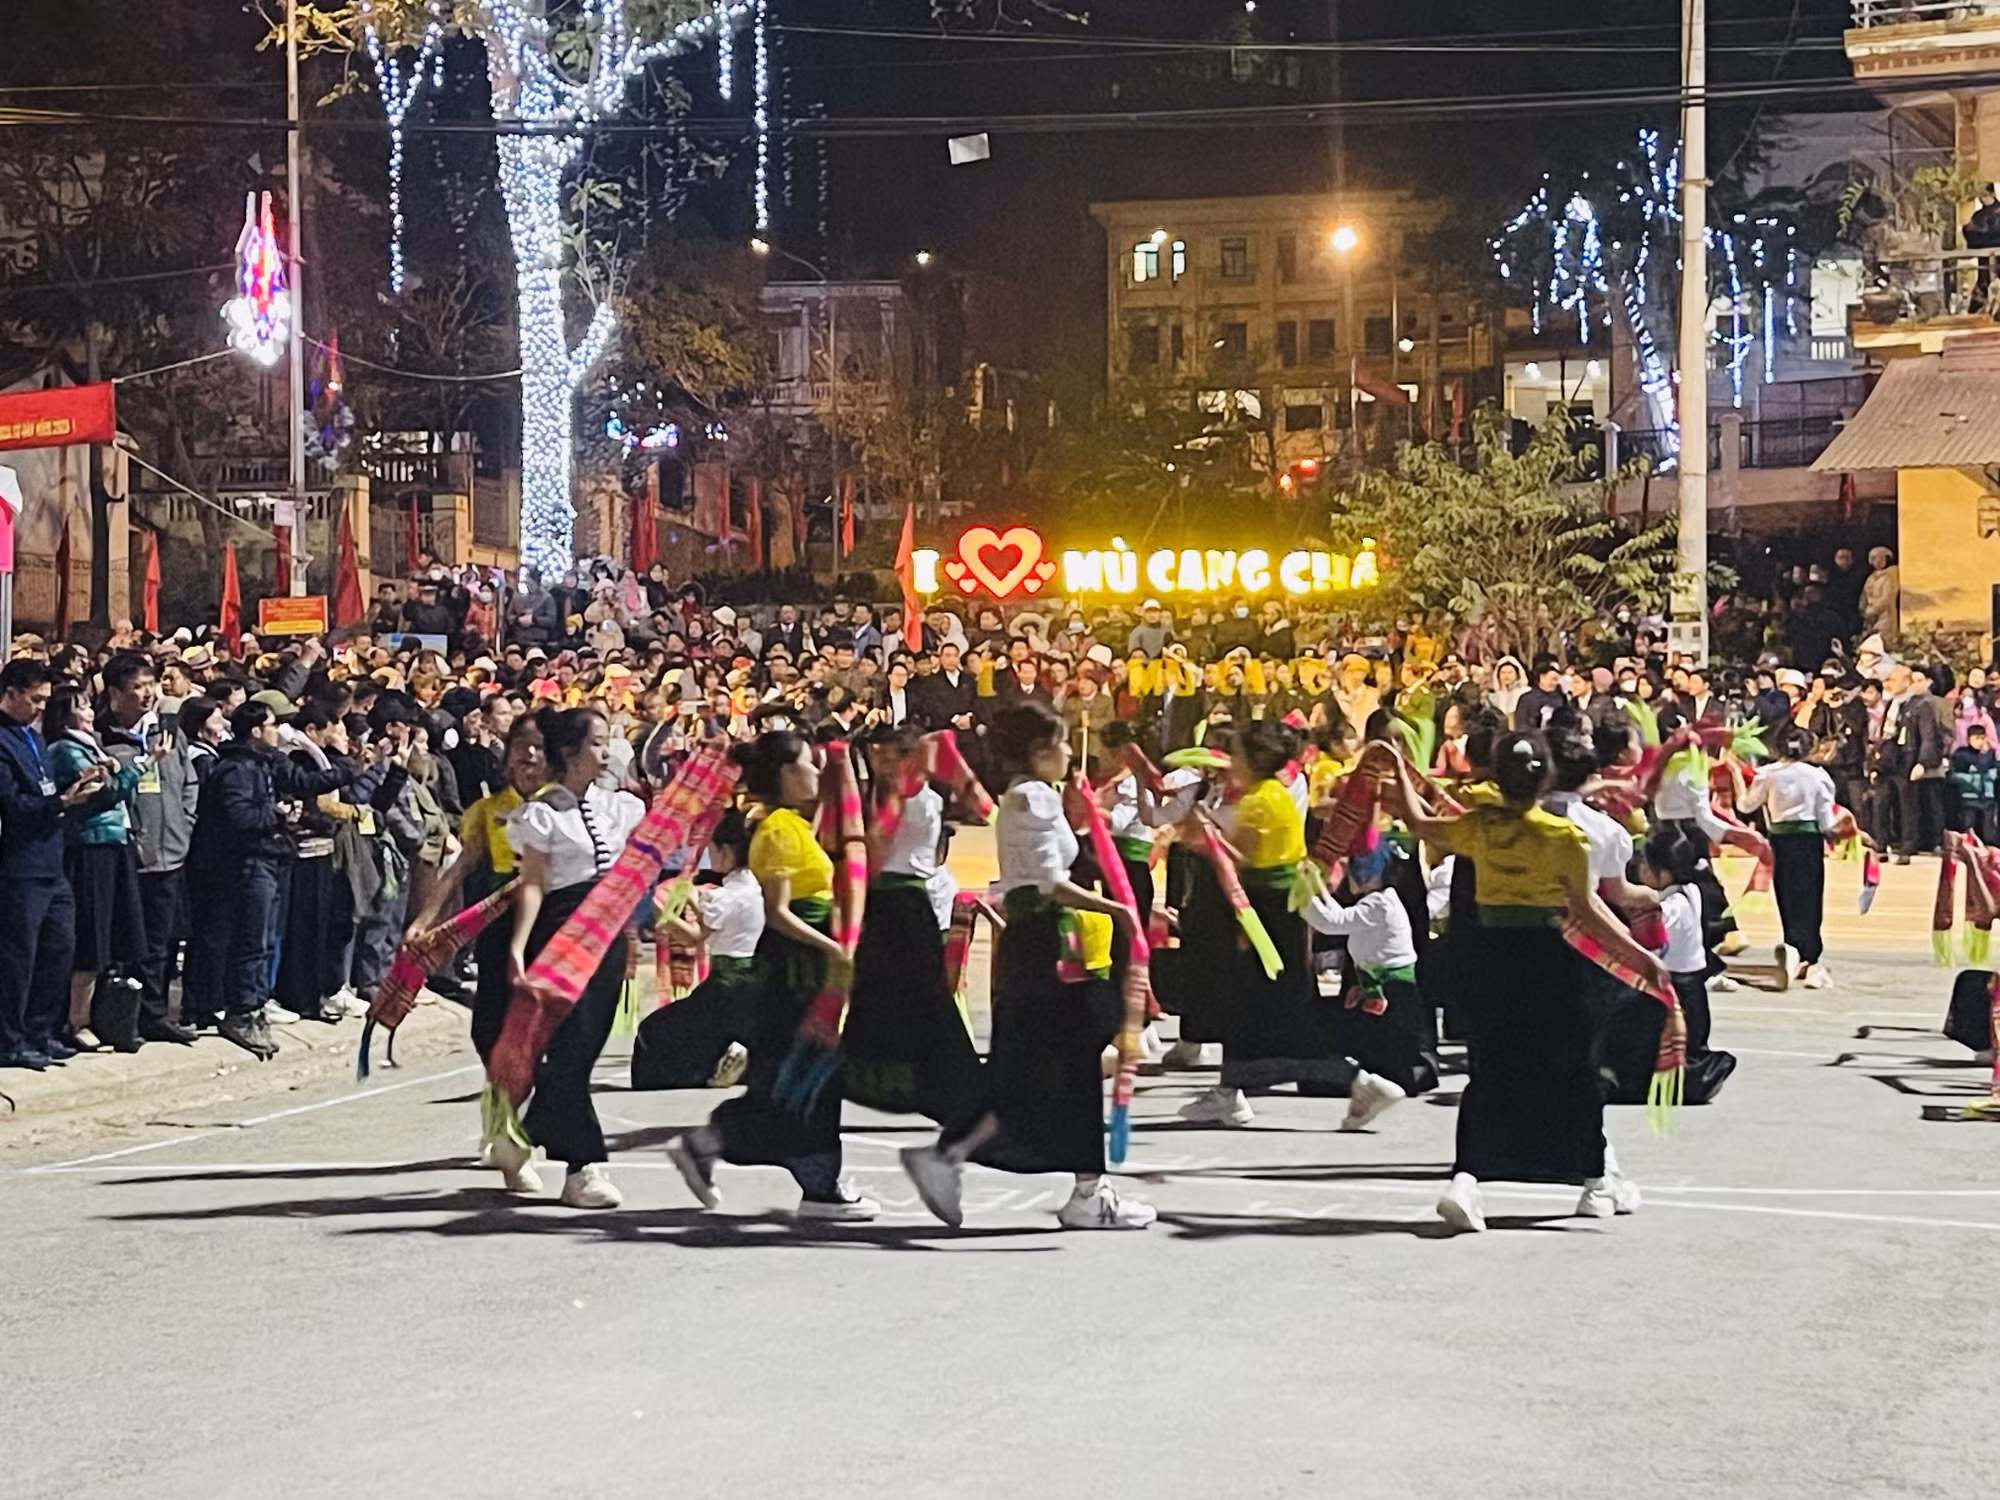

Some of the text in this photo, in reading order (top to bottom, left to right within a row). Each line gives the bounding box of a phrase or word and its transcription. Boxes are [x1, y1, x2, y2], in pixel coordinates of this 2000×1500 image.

[911, 549, 940, 593] I
[1063, 536, 1138, 593] MÙ
[1146, 549, 1271, 592] CANG
